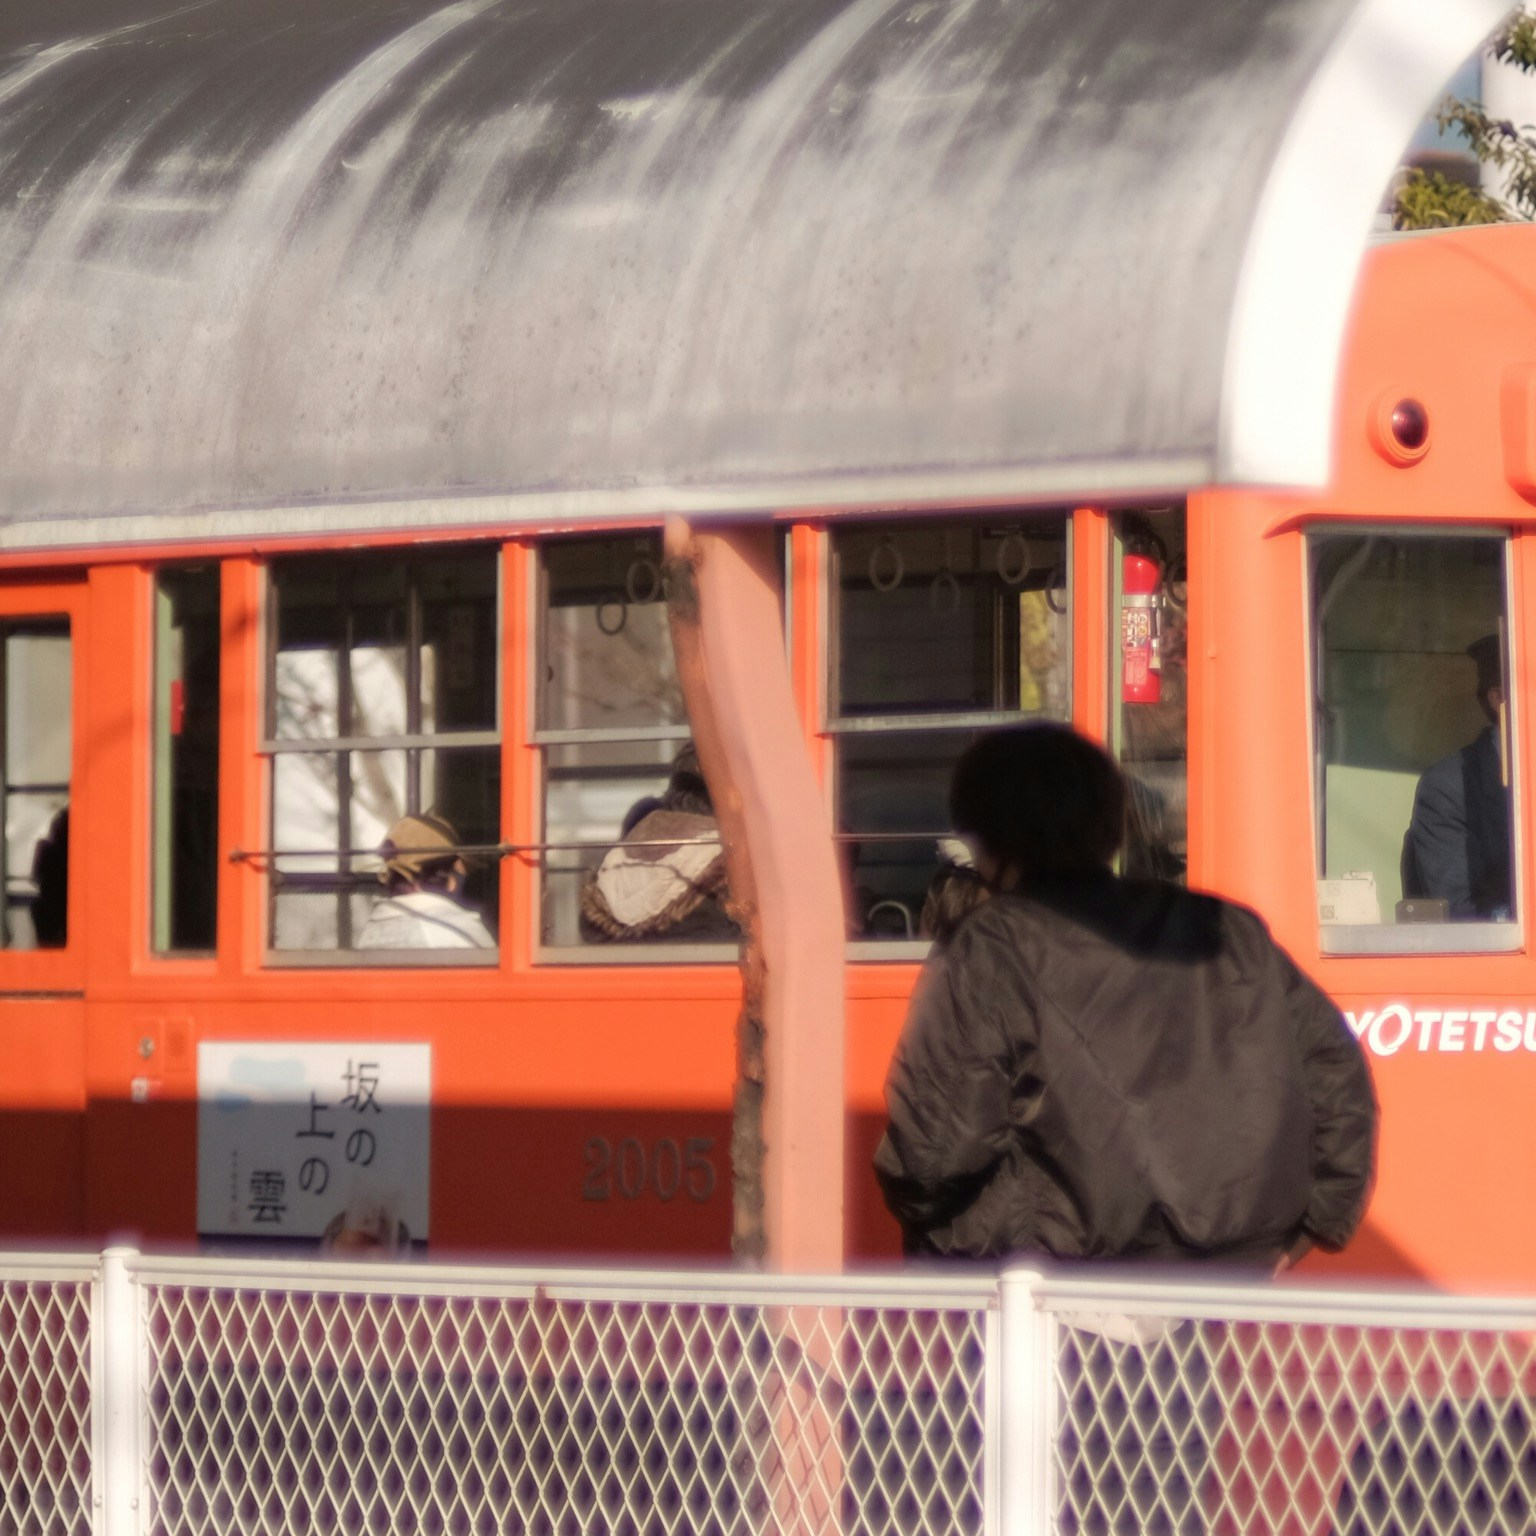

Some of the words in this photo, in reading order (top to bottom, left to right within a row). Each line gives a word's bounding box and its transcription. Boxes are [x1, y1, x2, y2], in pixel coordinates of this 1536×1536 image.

[296, 1088, 336, 1196] 上の
[340, 1058, 382, 1167] 坂の
[248, 1169, 287, 1224] 雲
[582, 1135, 716, 1203] 2005
